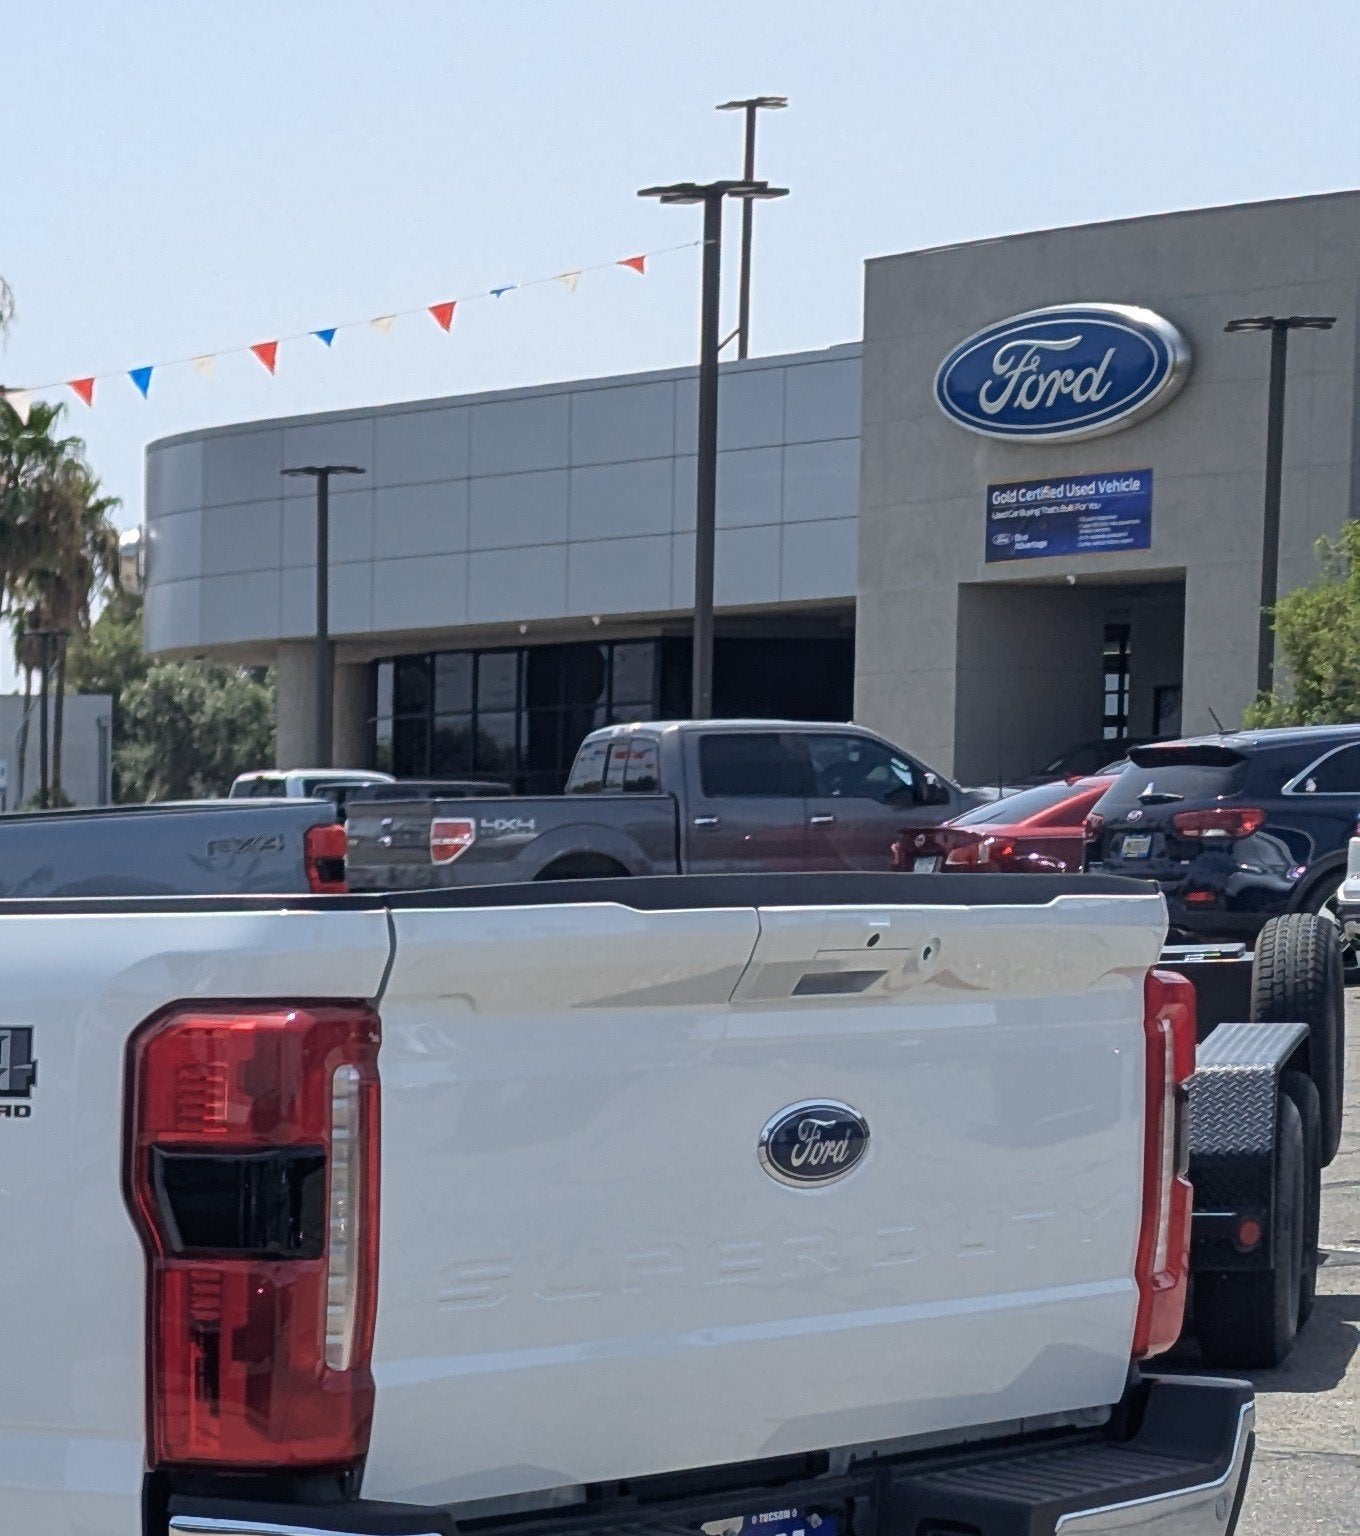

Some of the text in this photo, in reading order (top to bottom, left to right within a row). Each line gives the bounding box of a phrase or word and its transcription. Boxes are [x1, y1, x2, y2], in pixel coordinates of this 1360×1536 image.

[980, 334, 1117, 415] Ford
[991, 477, 1141, 505] Gold Certified Used Vehicle
[791, 1117, 850, 1167] Ford
[437, 1197, 1114, 1311] SUPER DUTY
